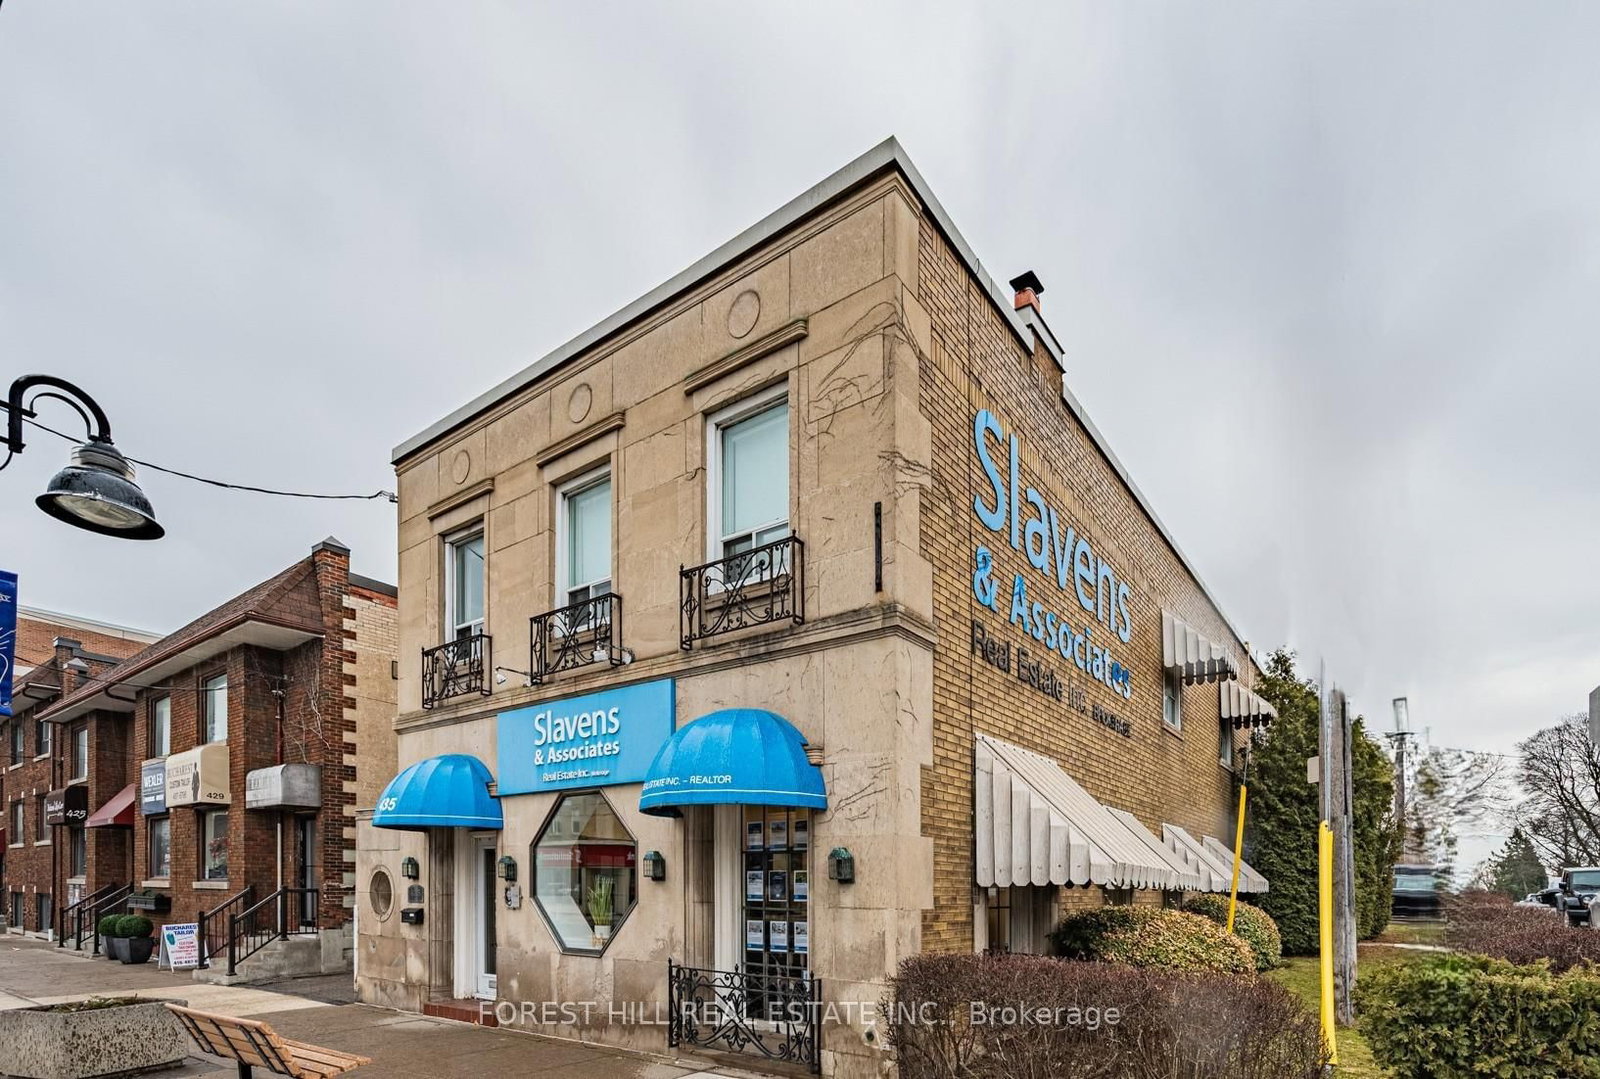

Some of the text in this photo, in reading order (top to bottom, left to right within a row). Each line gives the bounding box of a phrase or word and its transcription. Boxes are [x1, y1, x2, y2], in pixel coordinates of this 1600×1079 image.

[973, 408, 1133, 643] Slavens
[973, 546, 1131, 699] & Associates
[972, 619, 1010, 673] Real
[1018, 647, 1064, 701] Estate
[534, 707, 620, 746] Slavens
[534, 740, 620, 766] & Associates
[543, 772, 557, 782] Real
[557, 770, 578, 781] Estate
[689, 775, 732, 784] REALTOR
[206, 792, 225, 800] 429
[66, 809, 87, 819] 425
